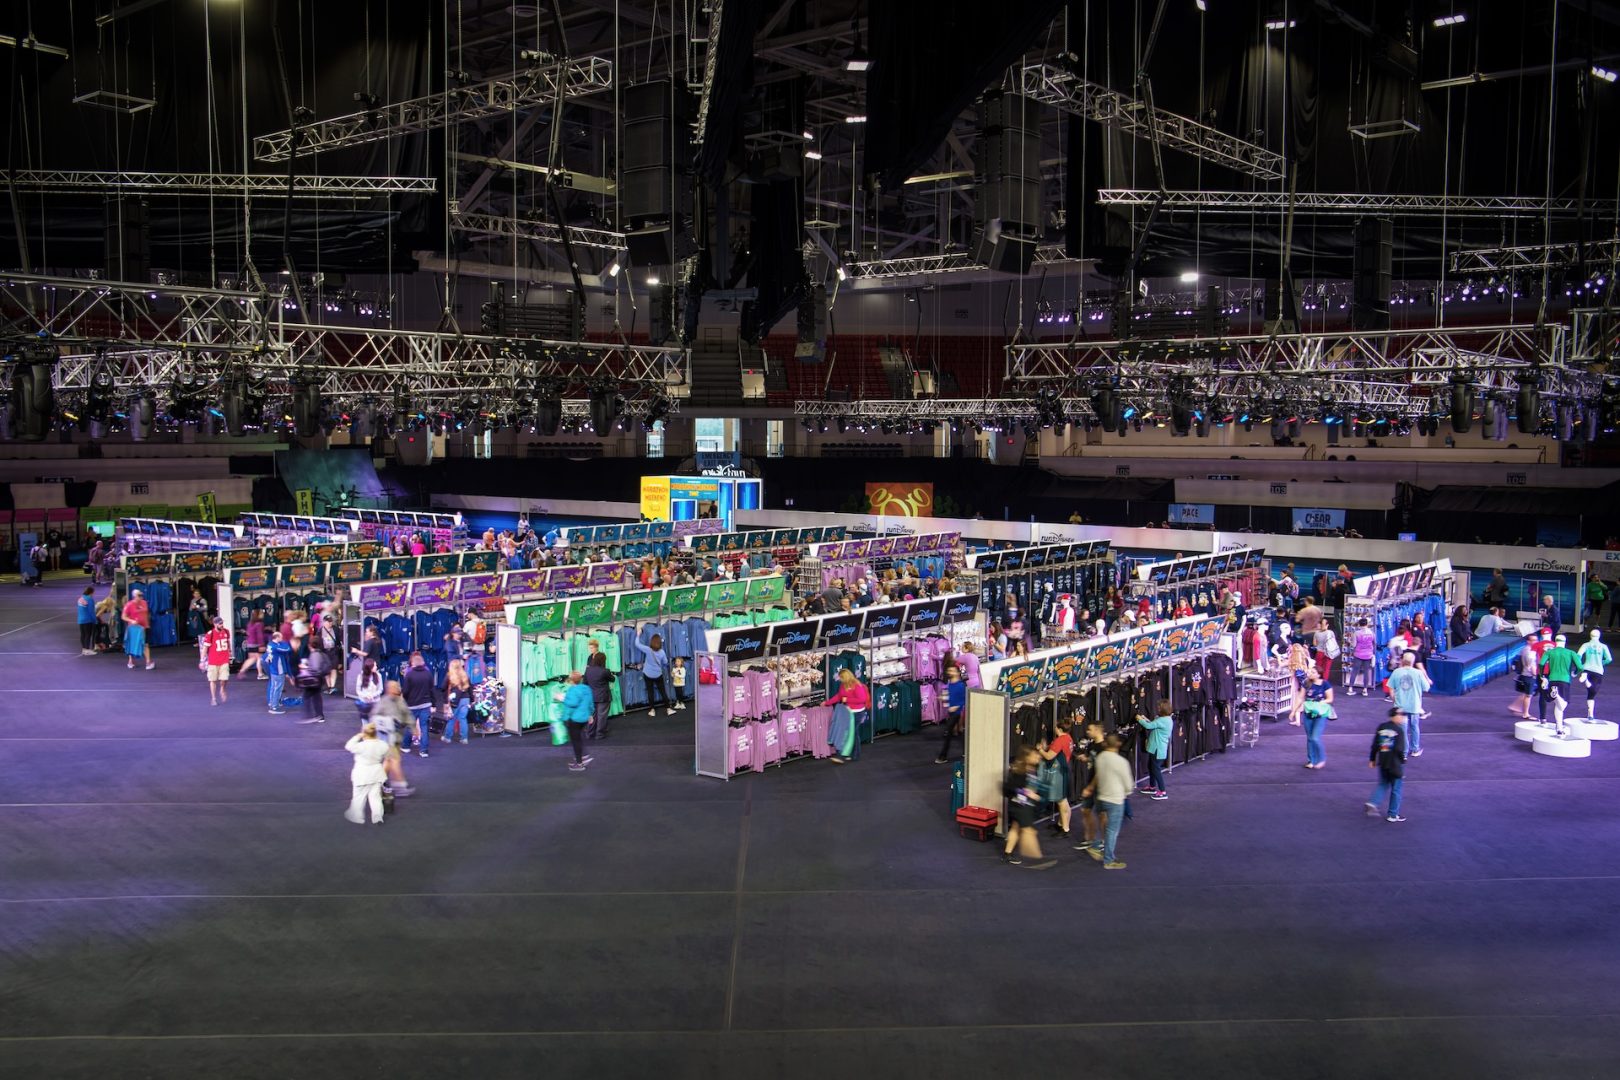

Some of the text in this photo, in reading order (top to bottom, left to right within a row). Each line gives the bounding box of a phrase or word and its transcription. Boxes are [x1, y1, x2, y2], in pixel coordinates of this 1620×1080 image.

[869, 616, 899, 629] runDisney
[825, 624, 857, 637] runDisney
[215, 639, 228, 651] 15
[776, 632, 811, 645] runDisney
[725, 638, 761, 653] runDisney
